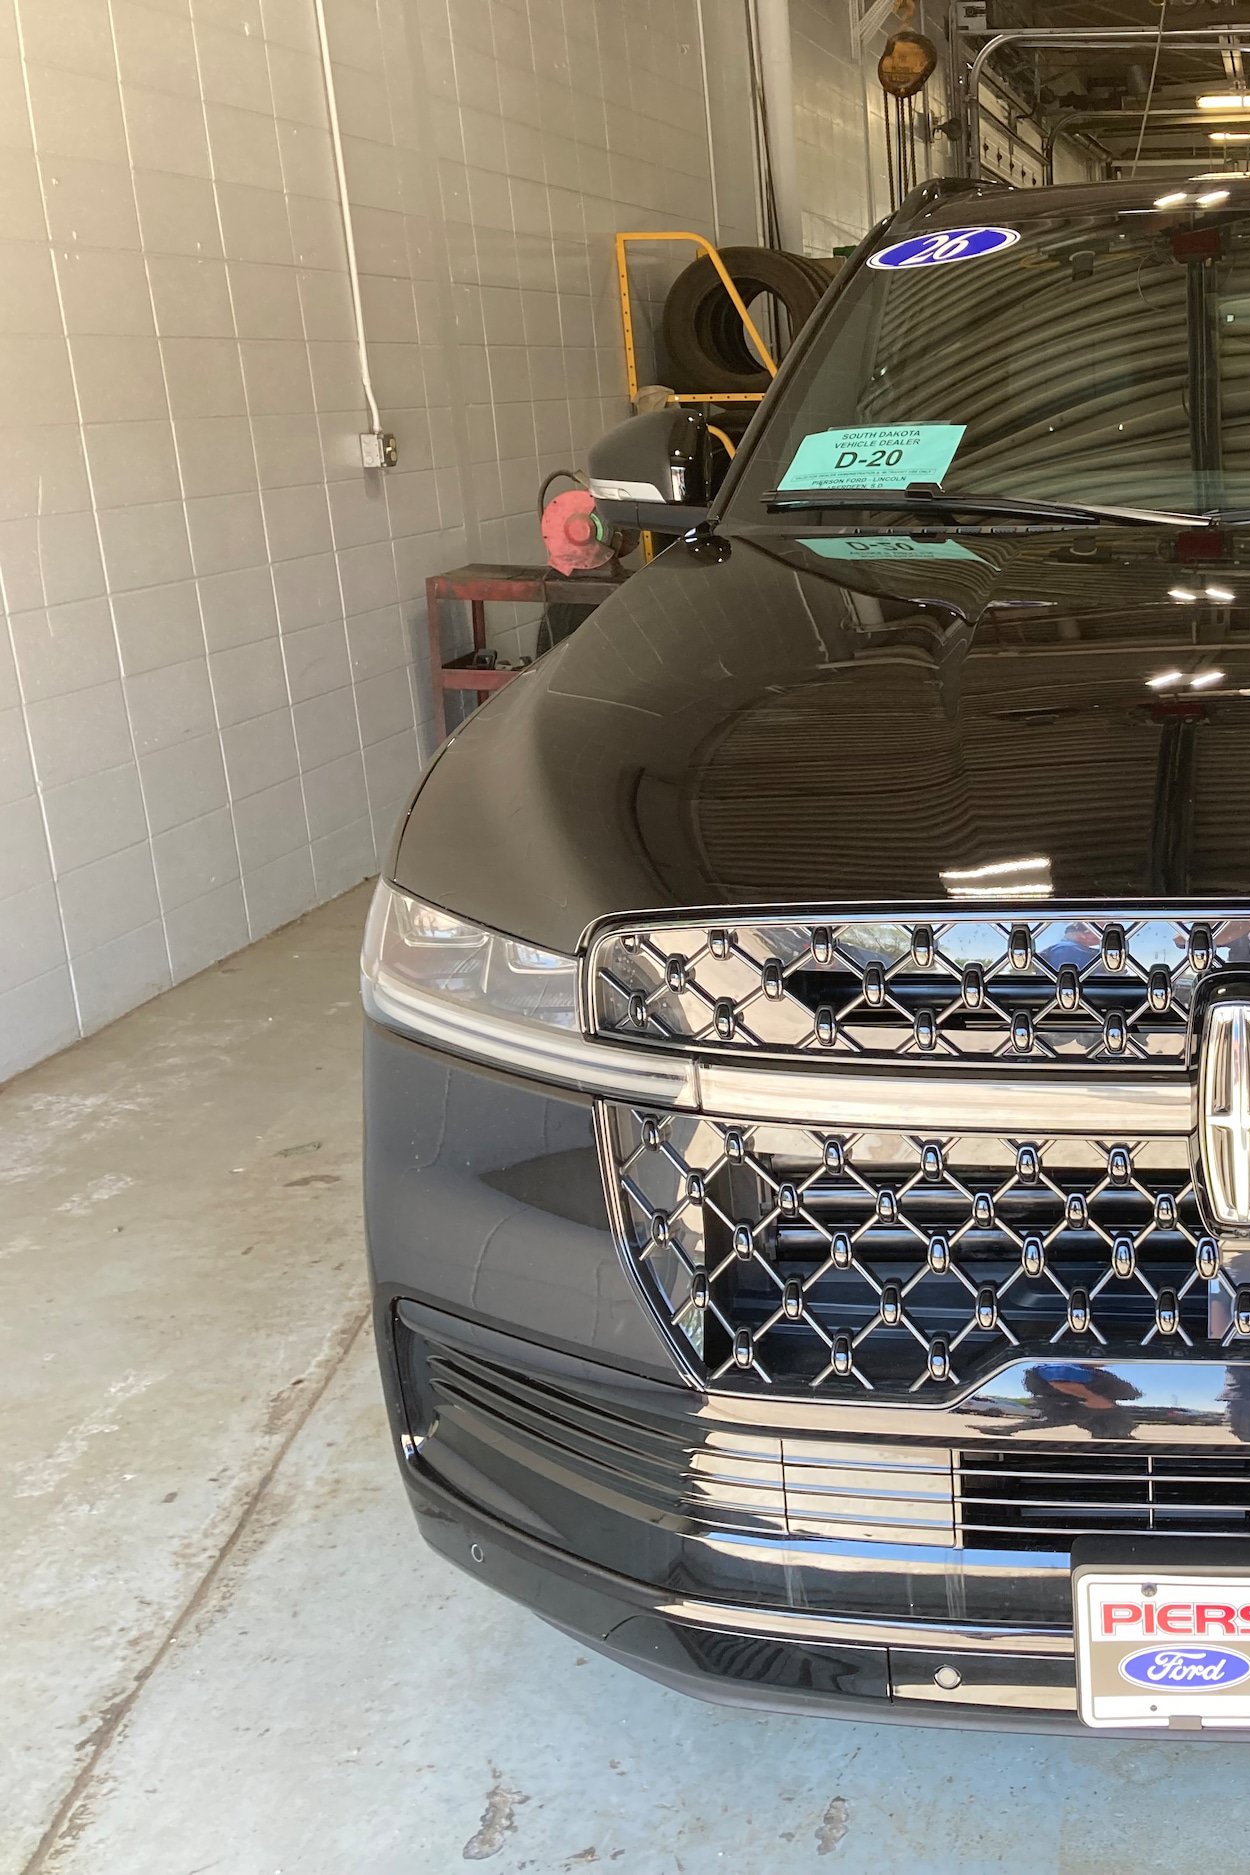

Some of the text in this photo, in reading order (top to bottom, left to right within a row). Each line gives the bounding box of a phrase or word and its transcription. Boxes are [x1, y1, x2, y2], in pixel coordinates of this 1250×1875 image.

[898, 229, 984, 265] 26
[834, 438, 921, 449] VEHICLE DEALER
[842, 430, 921, 440] SOUTH DAKOTA
[834, 449, 904, 469] D-20
[1147, 1651, 1226, 1682] Ford
